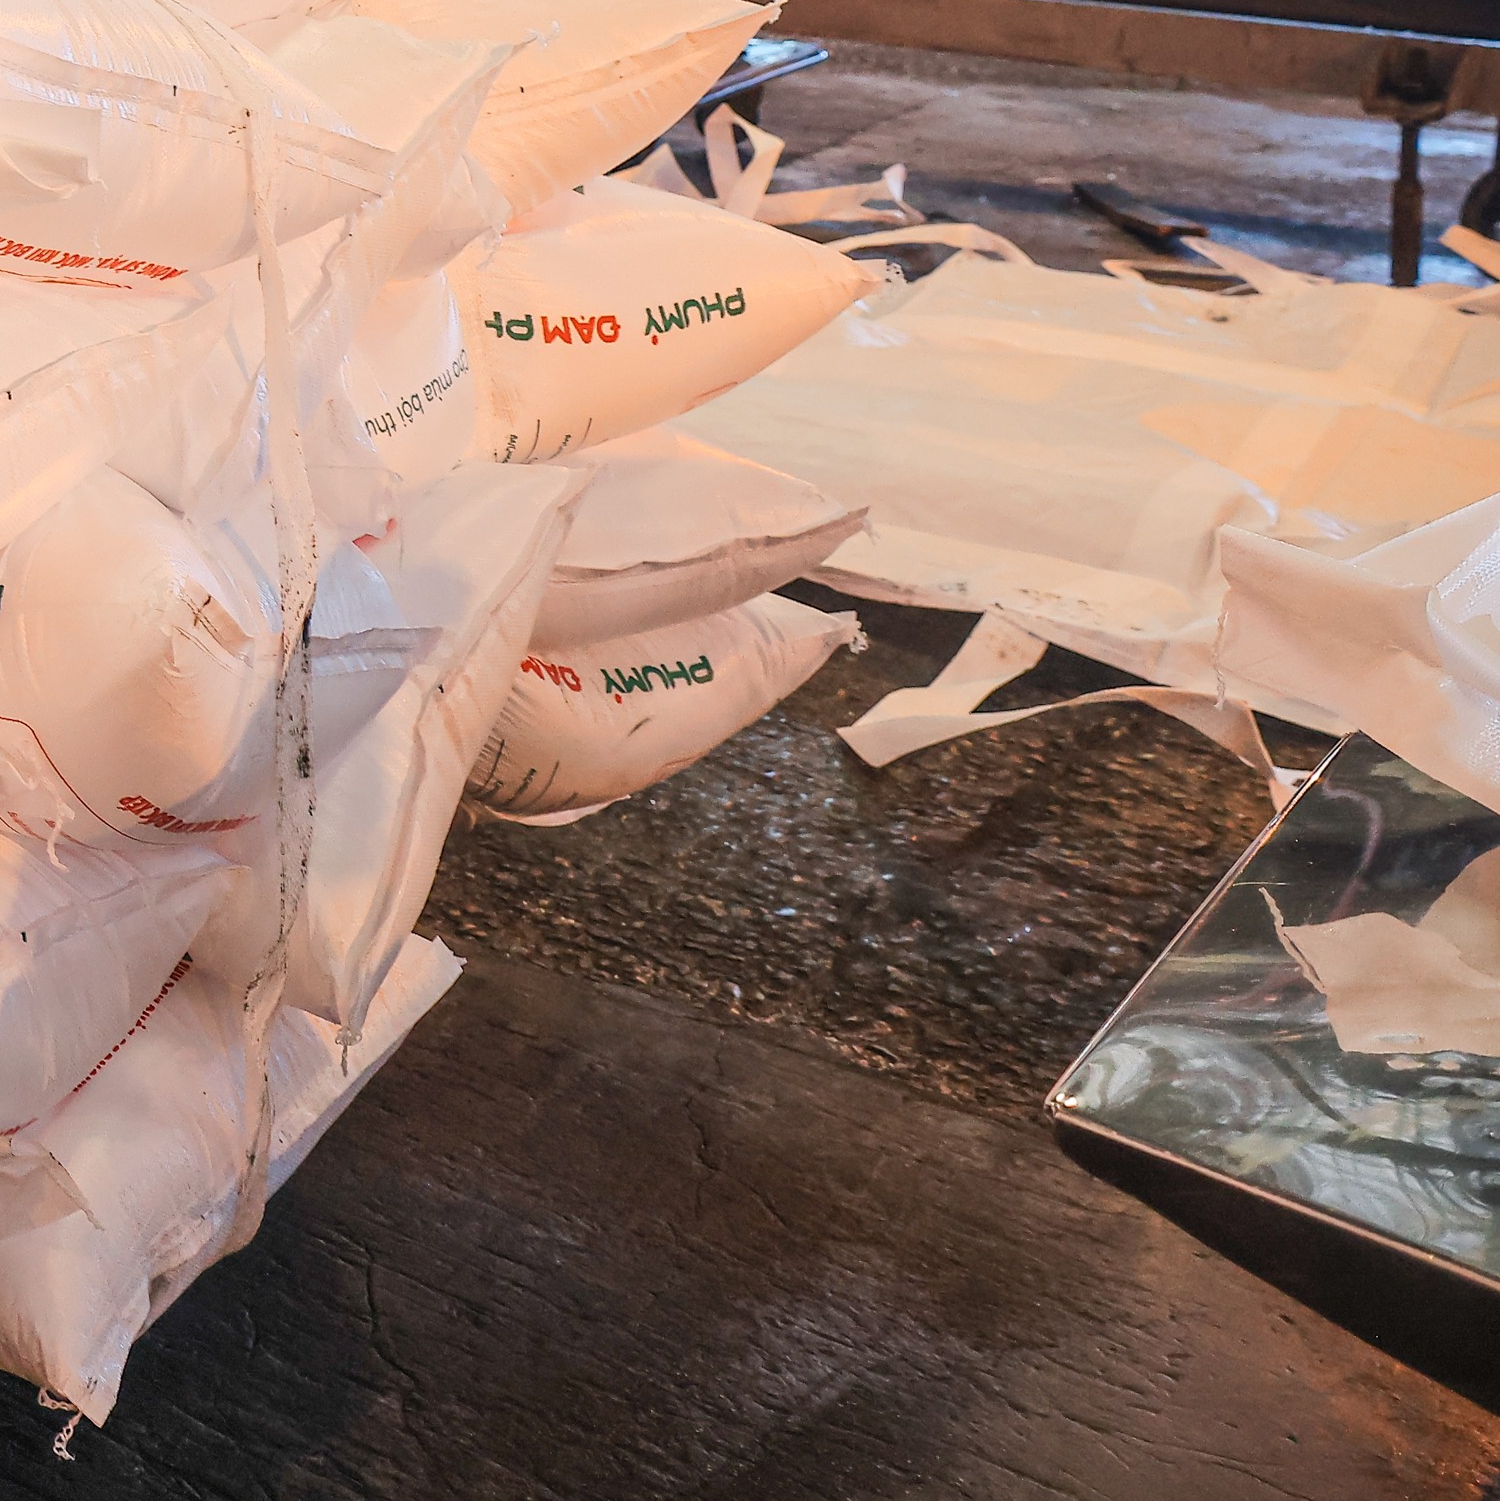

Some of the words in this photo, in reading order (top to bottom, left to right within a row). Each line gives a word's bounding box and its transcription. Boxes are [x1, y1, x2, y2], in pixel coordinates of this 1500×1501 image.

[541, 314, 622, 344] ĐẠM
[644, 287, 747, 345] PHUMY
[423, 369, 453, 402] mùa
[364, 411, 397, 438] thu
[396, 393, 425, 427] bội
[600, 655, 715, 704] PHUMY
